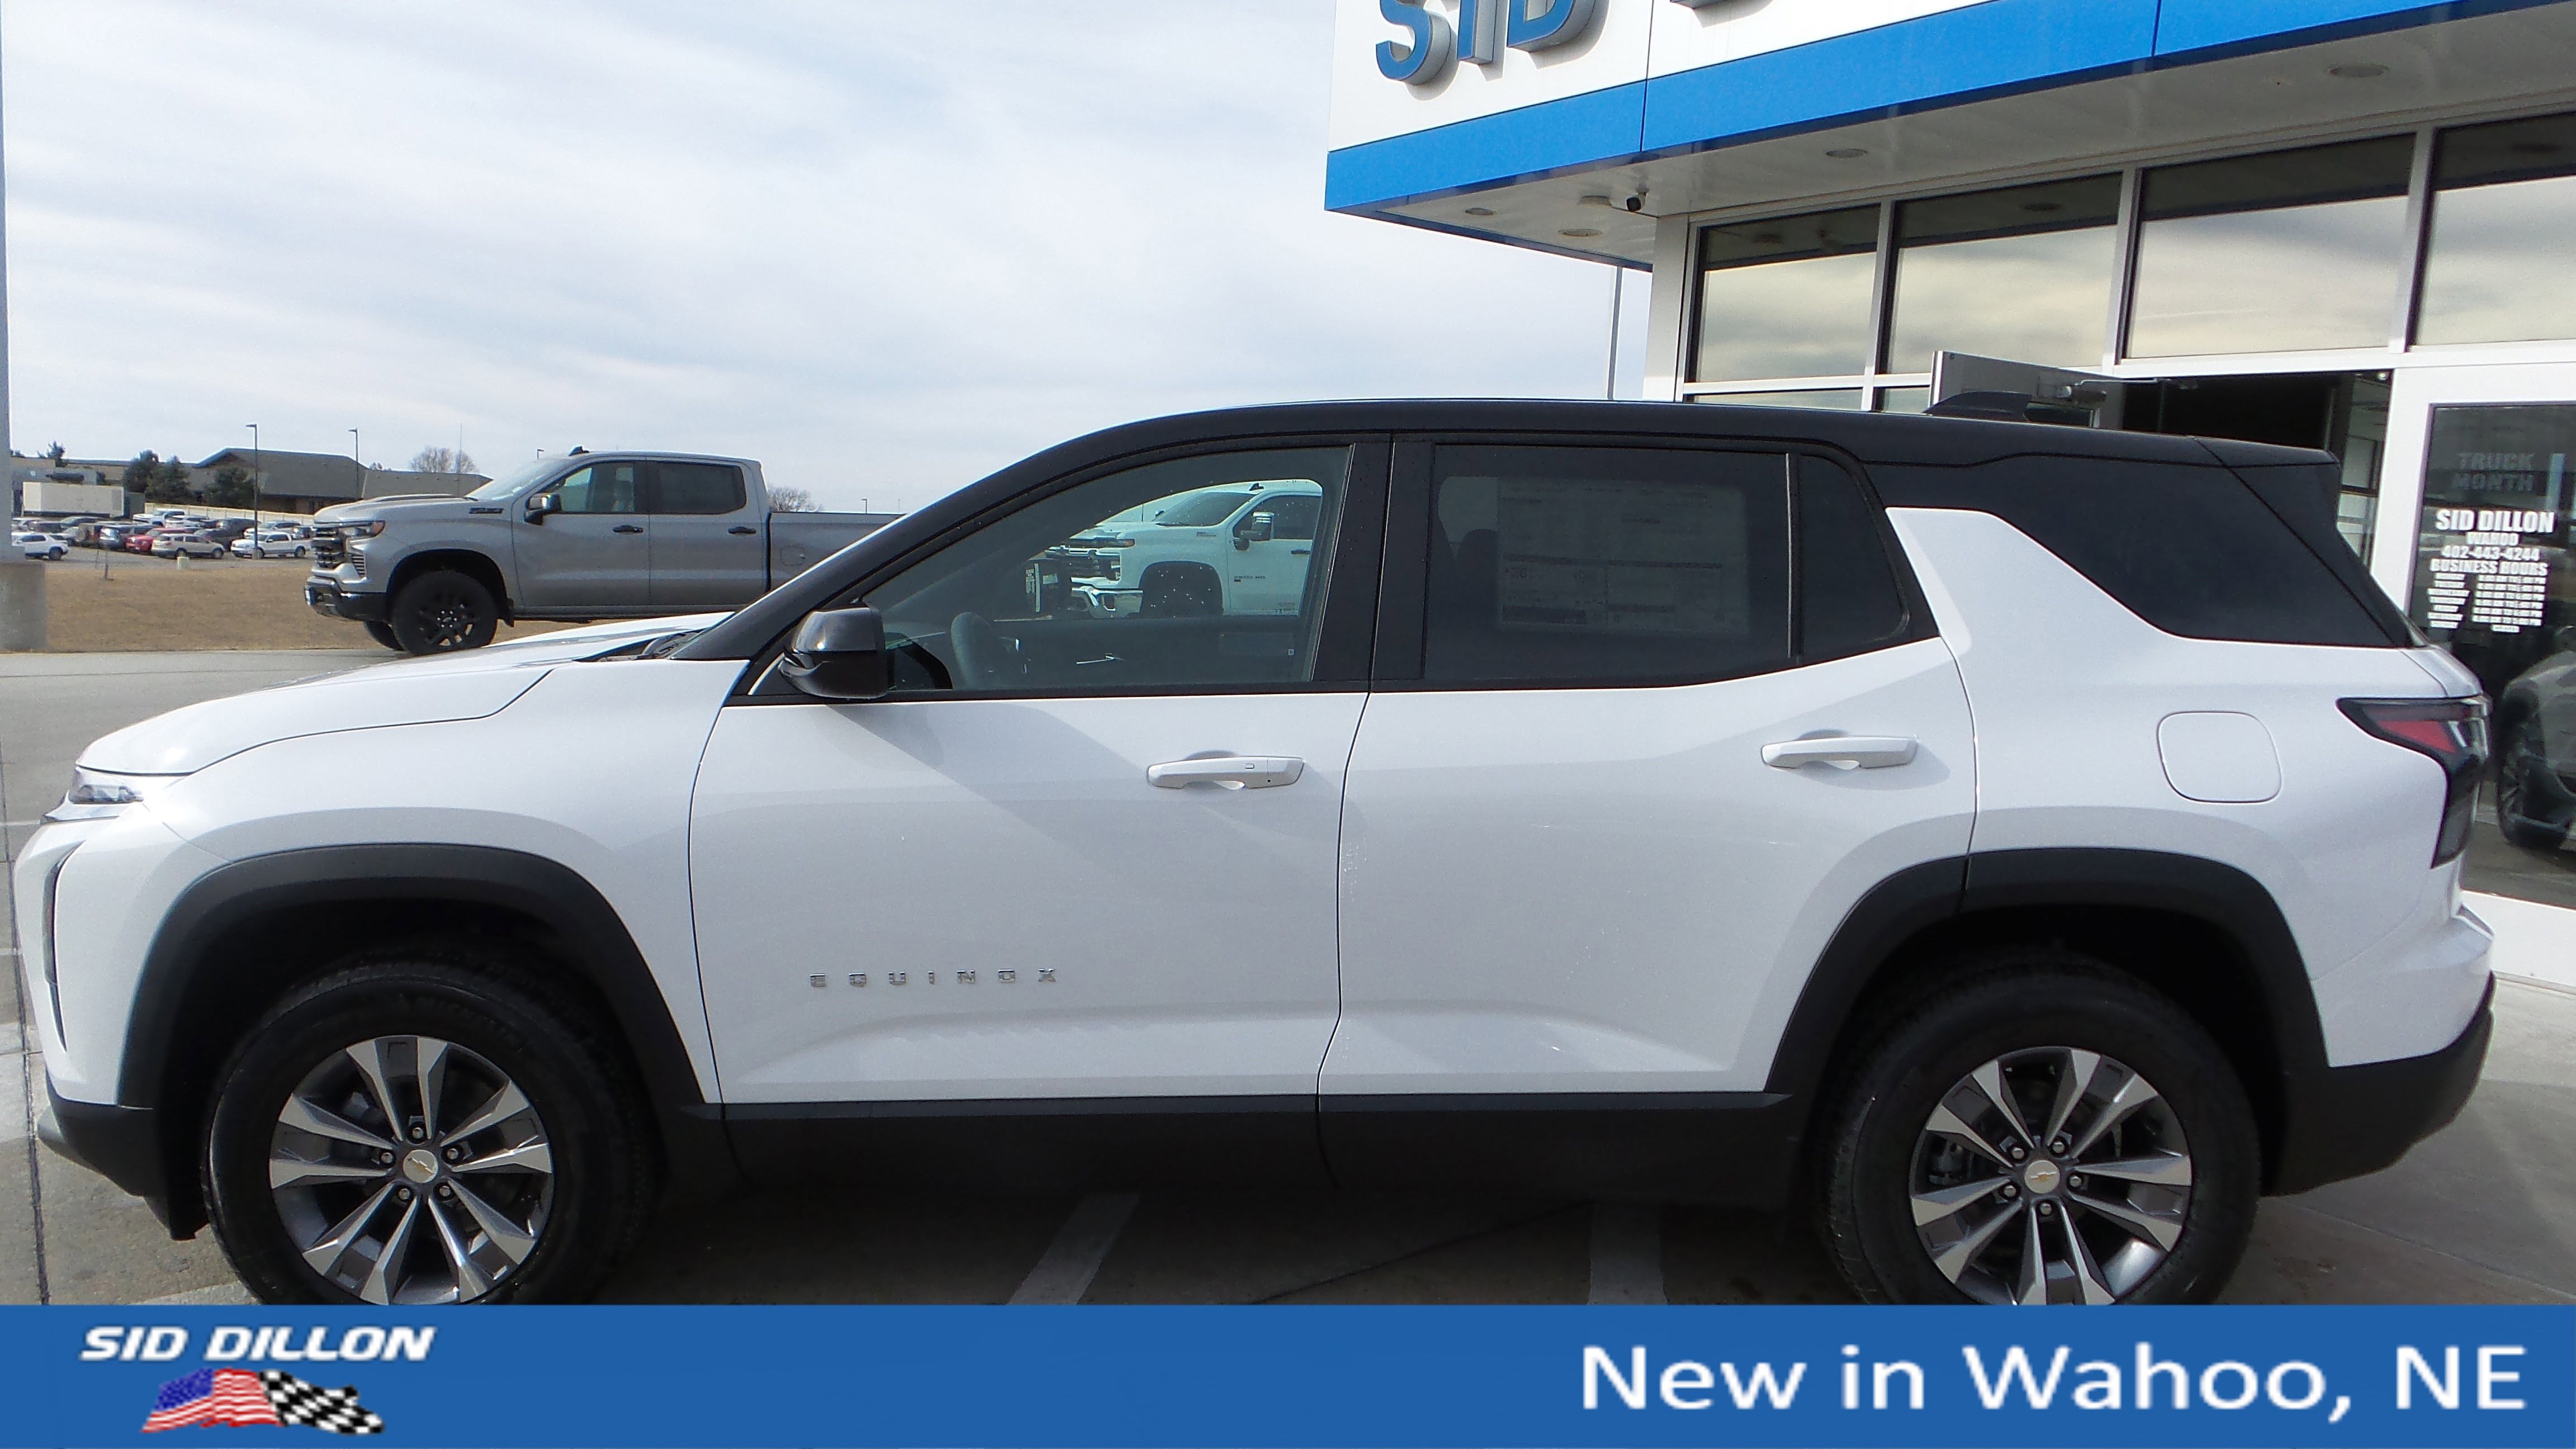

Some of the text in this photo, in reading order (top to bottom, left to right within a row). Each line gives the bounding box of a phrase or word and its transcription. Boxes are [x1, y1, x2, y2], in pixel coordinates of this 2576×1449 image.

[2459, 452, 2535, 470] TRUCK
[2436, 509, 2555, 533] SID DILLON
[2466, 532, 2519, 546] WAHOO
[2441, 545, 2540, 561] 402-443-4244
[2430, 558, 2548, 576] BUSINESS HOURS
[809, 967, 1057, 987] EQUINOX
